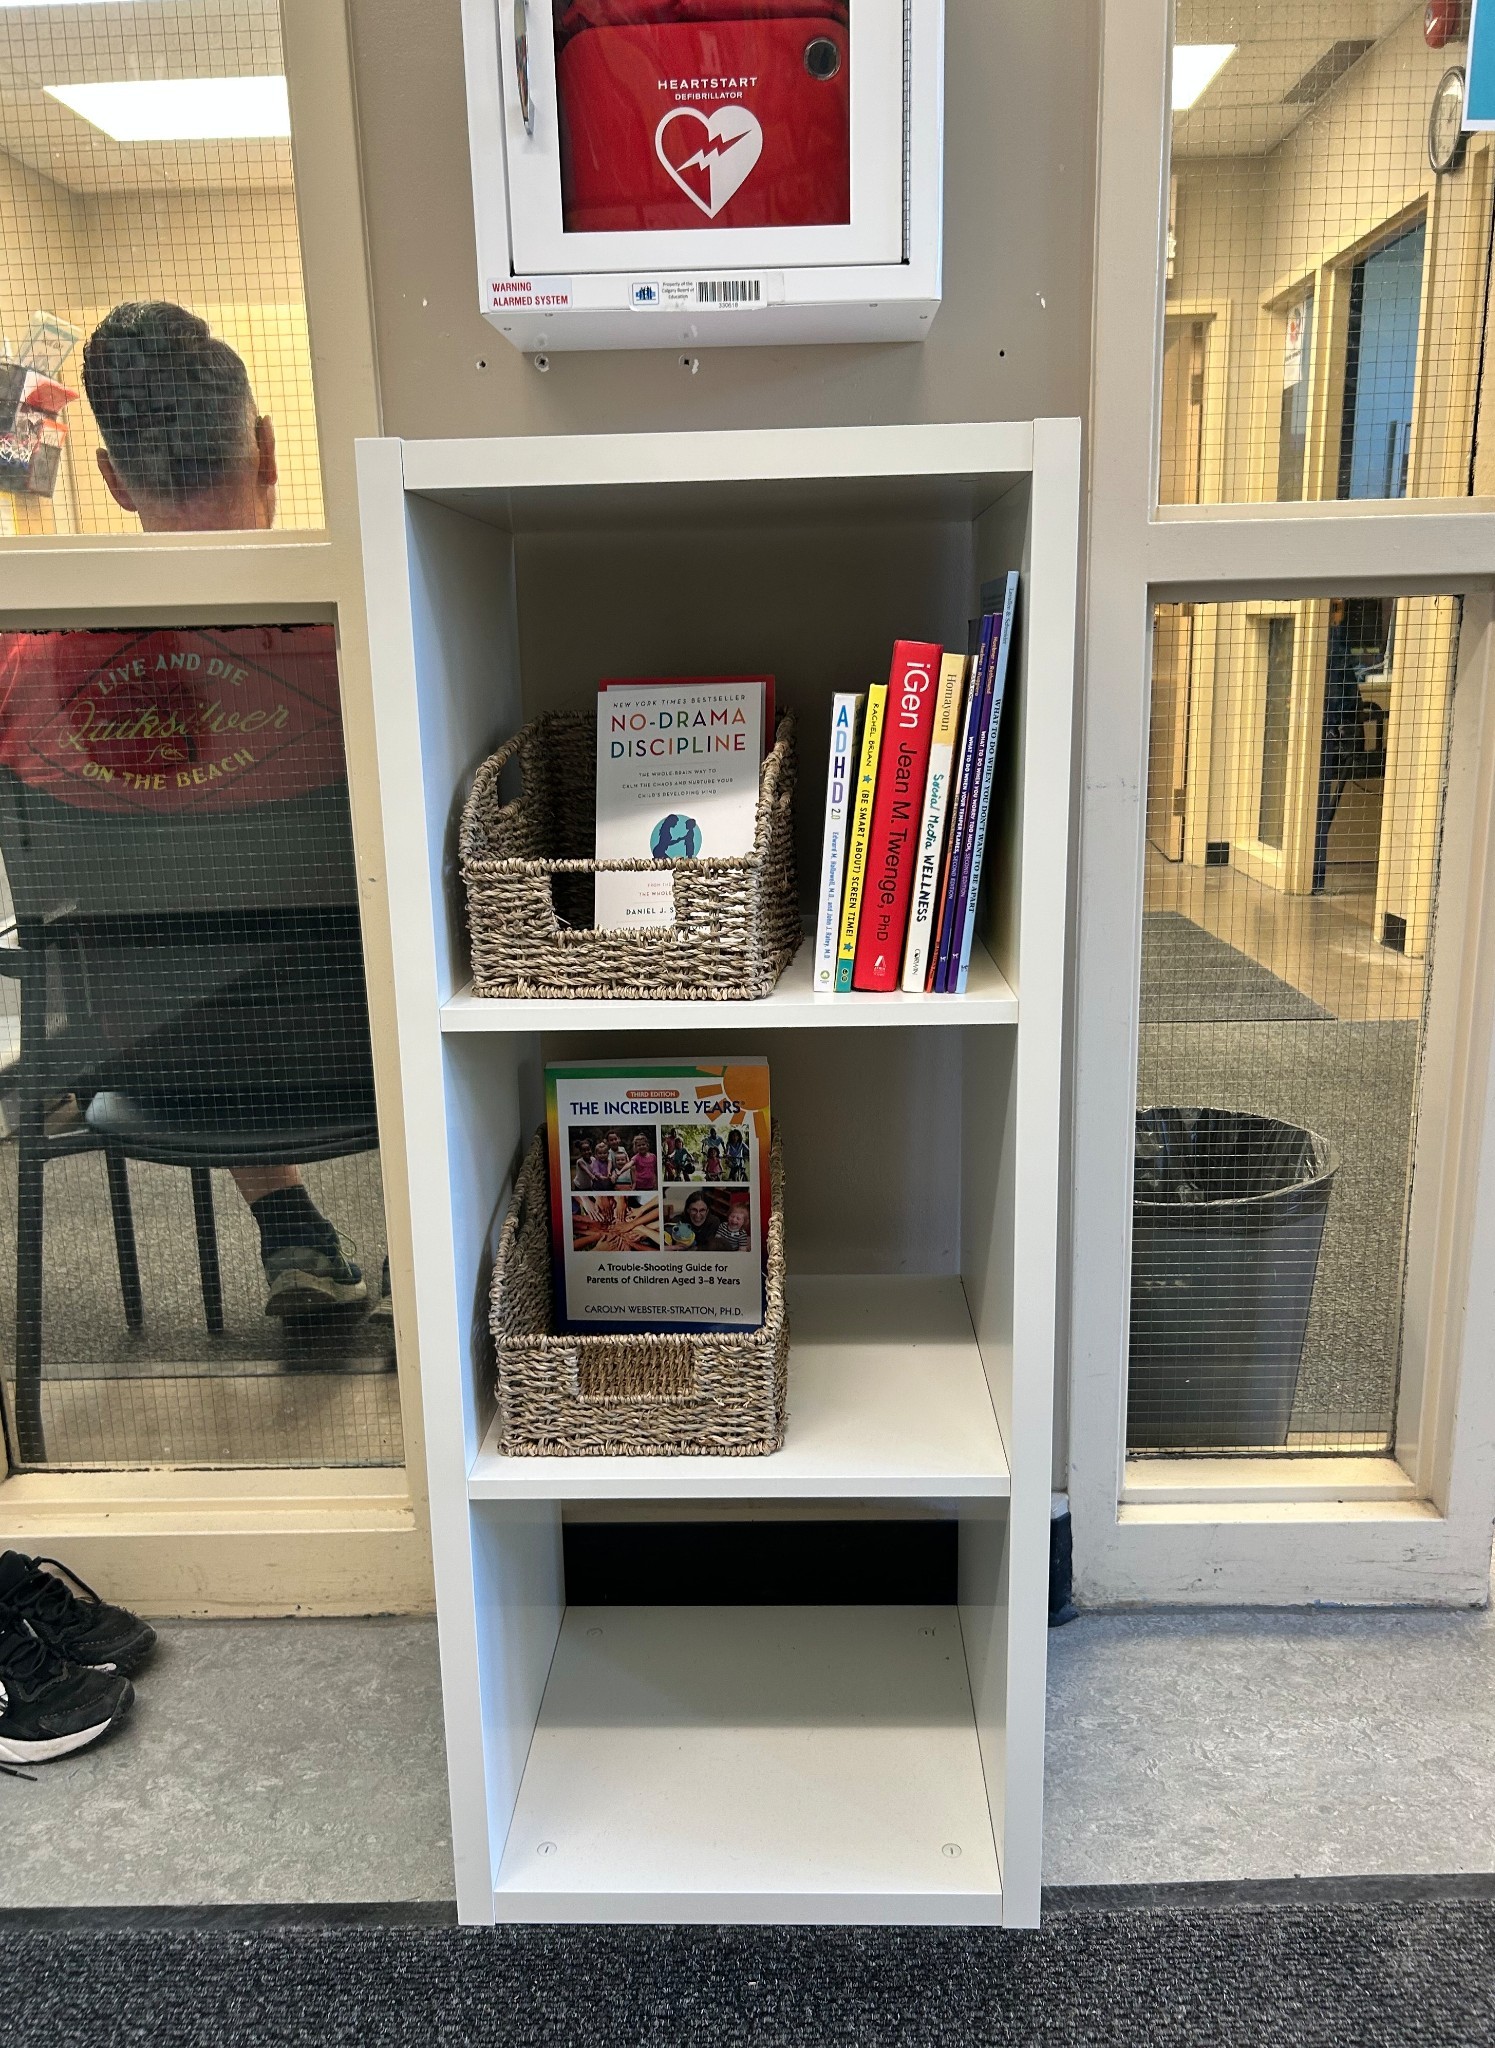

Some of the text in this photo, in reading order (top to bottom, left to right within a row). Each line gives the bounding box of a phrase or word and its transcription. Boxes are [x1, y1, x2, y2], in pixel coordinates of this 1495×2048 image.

[658, 76, 758, 90] HEARTSTART
[674, 92, 743, 100] DEFIBRILLATOR
[492, 282, 532, 292] WARNING
[492, 295, 569, 307] ALARMED SYSTEM
[98, 653, 249, 695] LIVE AND DIE
[691, 694, 746, 704] BESTSELLER
[898, 662, 931, 728] iGen
[941, 674, 957, 731] Homayoun
[58, 700, 290, 750] Quiksilver
[611, 708, 746, 732] NO-DRAMA
[866, 703, 879, 766] RACHEL BRIAN
[992, 728, 998, 739] TO
[611, 733, 746, 758] DISCIPLINE
[989, 741, 996, 754] DO
[82, 749, 255, 790] ON THE BEACH
[831, 705, 848, 820] ADHD 2.0
[895, 742, 917, 793] Jean
[964, 764, 971, 772] DO
[977, 758, 983, 767] DO
[985, 757, 994, 783] WHEN
[974, 768, 982, 785] WHEN
[858, 807, 868, 838] SMART
[890, 801, 910, 824] M.
[957, 808, 965, 830] TEMPER
[980, 806, 988, 831] DON'T
[831, 832, 839, 853] Edward
[917, 774, 944, 923] Social Media WELLNESS
[953, 831, 963, 854] FLARES,
[965, 834, 973, 852] MUCH,
[975, 833, 986, 858] WANT
[853, 841, 863, 873] ABOUT)
[950, 855, 959, 877] SECOND
[962, 853, 970, 875] SECOND
[974, 861, 980, 872] TO
[877, 829, 908, 909] Twenge,
[972, 874, 980, 885] BE
[850, 877, 860, 909] SCREEN
[960, 876, 968, 897] EDITION
[626, 907, 656, 915] DANIEL
[969, 886, 978, 913] APART
[846, 912, 856, 937] TIME!
[876, 914, 890, 941] PhD
[912, 948, 920, 975] CORWIN
[570, 1102, 599, 1115] THE
[604, 1101, 689, 1114] INCREDIBLE
[607, 1263, 683, 1273] Trouble-Shooting
[685, 1264, 712, 1272] Guide
[715, 1264, 728, 1272] for
[586, 1276, 619, 1284] Parents
[621, 1276, 631, 1284] of
[633, 1276, 669, 1284] Children
[672, 1276, 695, 1286] Aged
[717, 1277, 740, 1286] Years
[584, 1305, 744, 1316] CAROLYN WEBSTER-STRATTON, PH.D.
